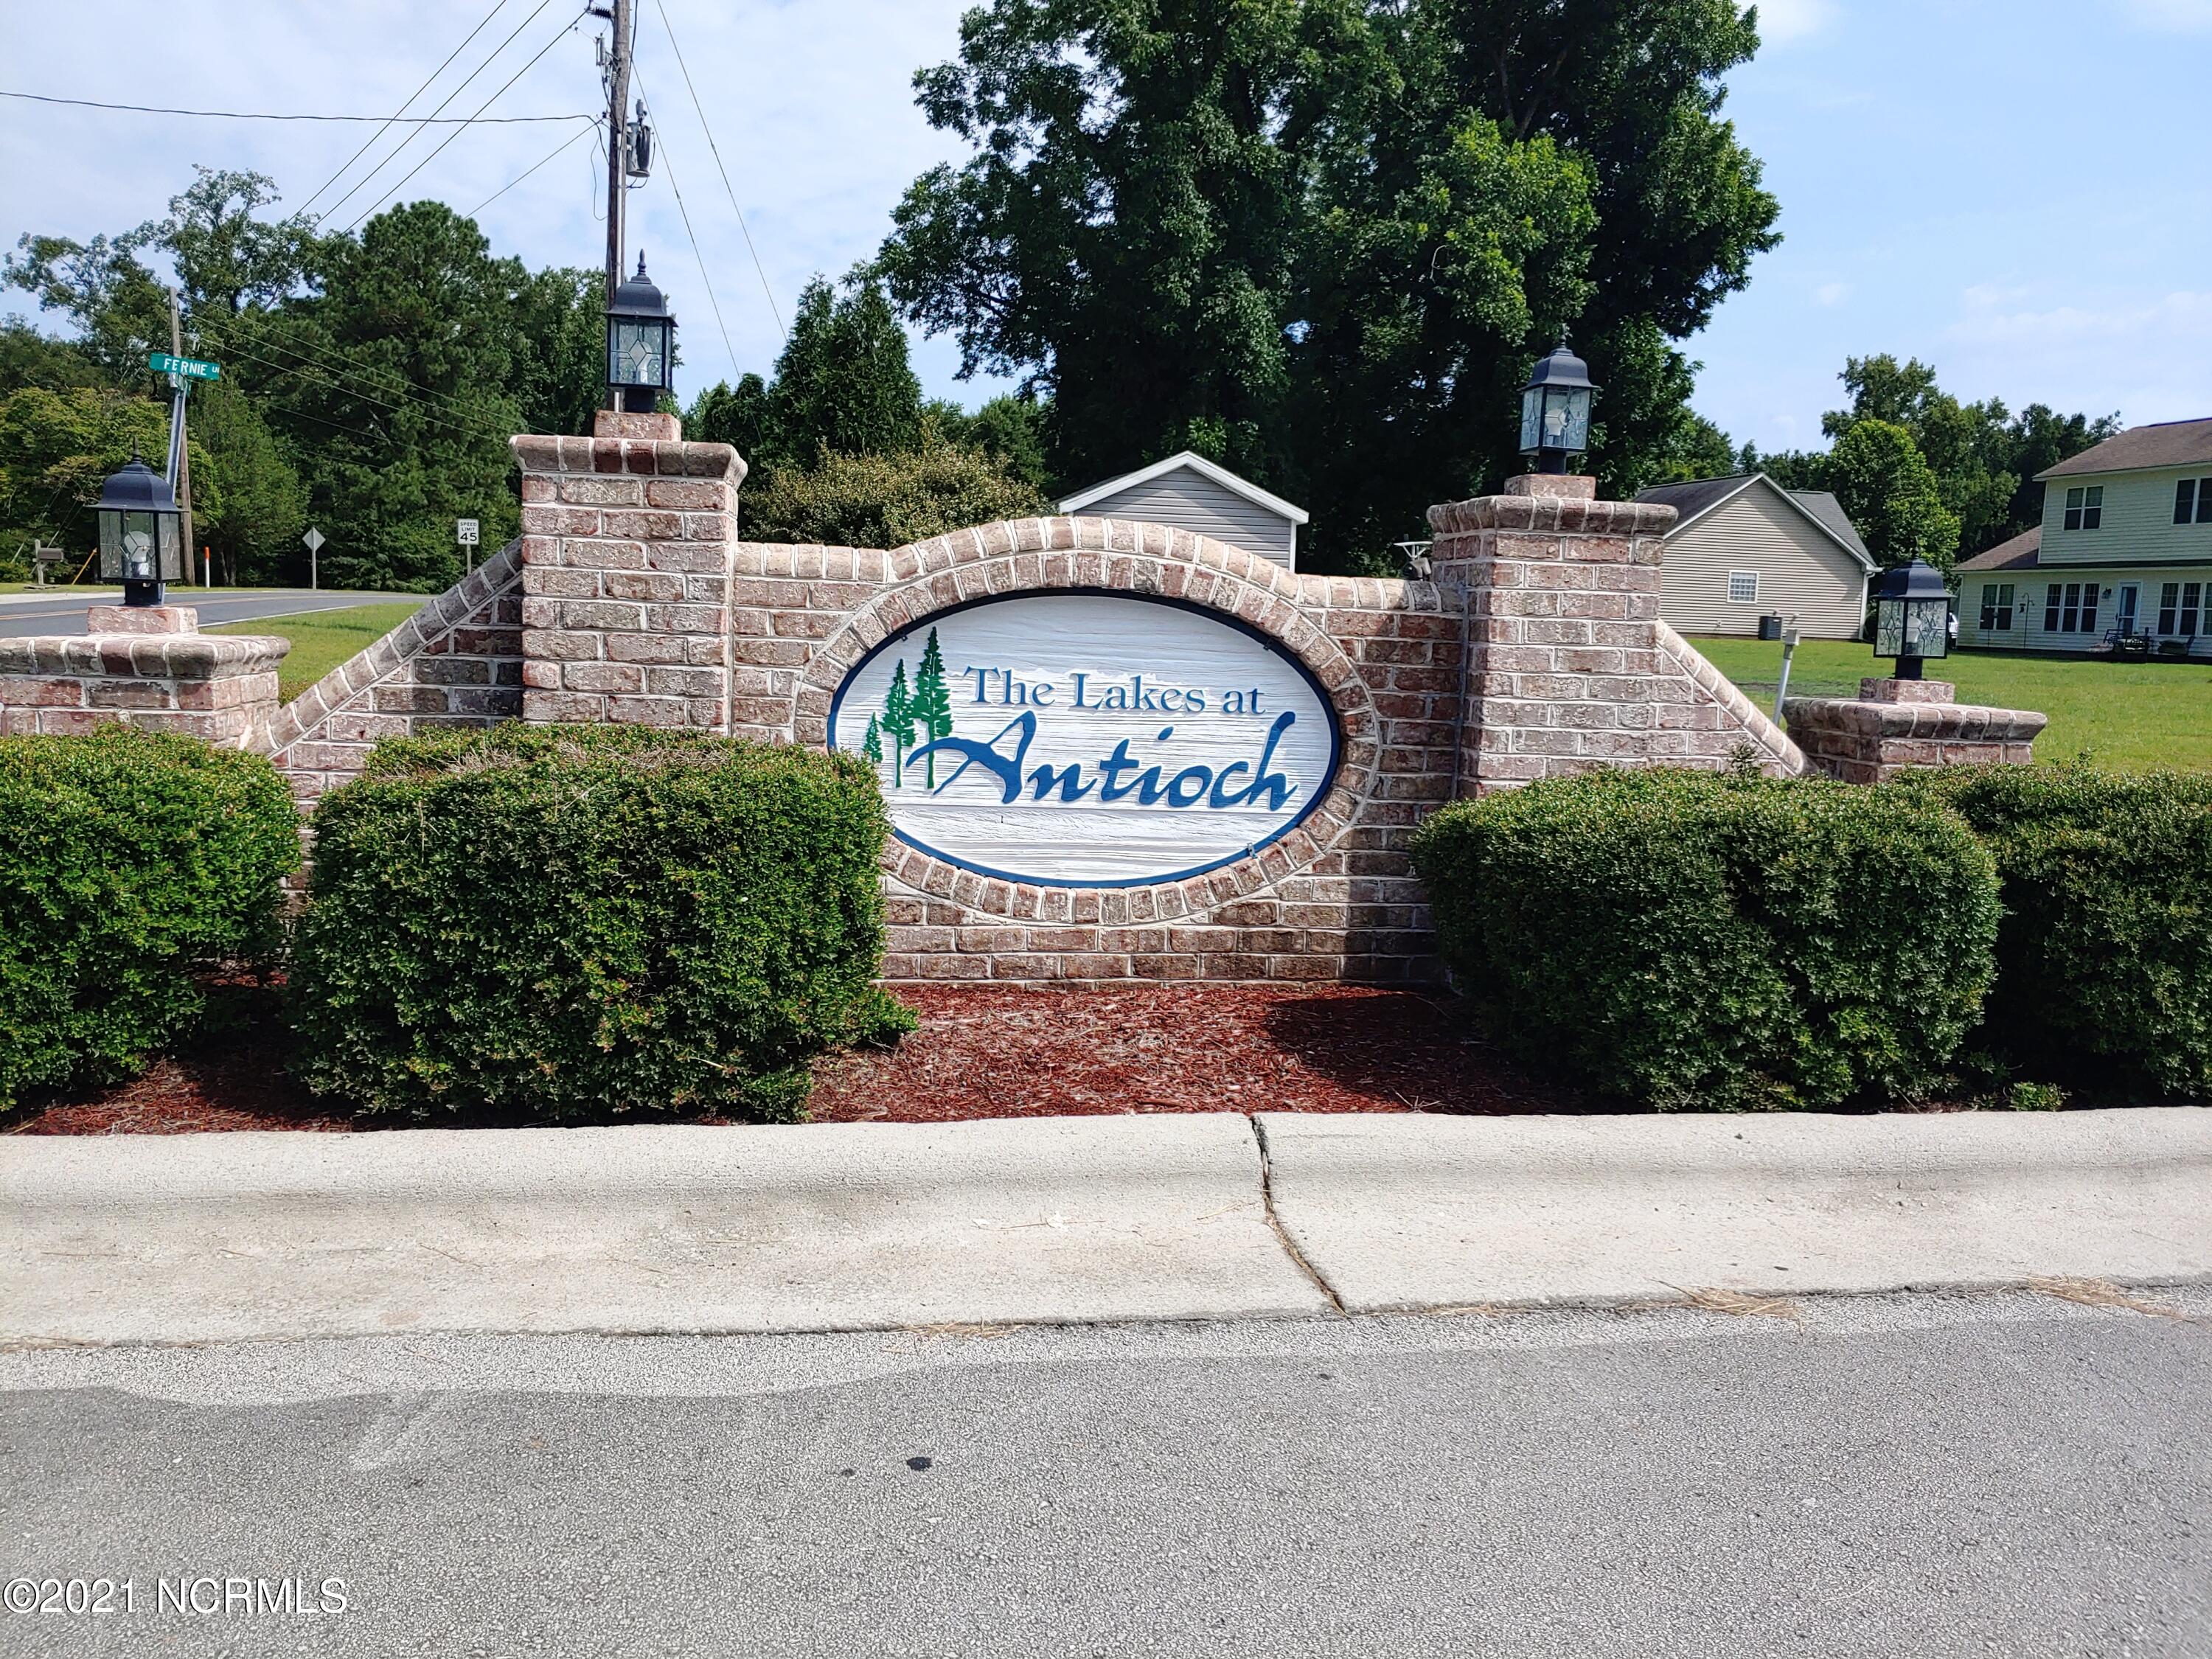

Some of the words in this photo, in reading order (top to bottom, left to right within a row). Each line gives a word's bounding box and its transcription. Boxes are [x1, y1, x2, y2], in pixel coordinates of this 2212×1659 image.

[164, 358, 207, 376] FERNIE
[460, 532, 477, 541] 45
[964, 666, 1055, 707] The
[1069, 672, 1206, 714] Lakes
[1223, 686, 1266, 714] at
[905, 710, 1299, 812] Antioch
